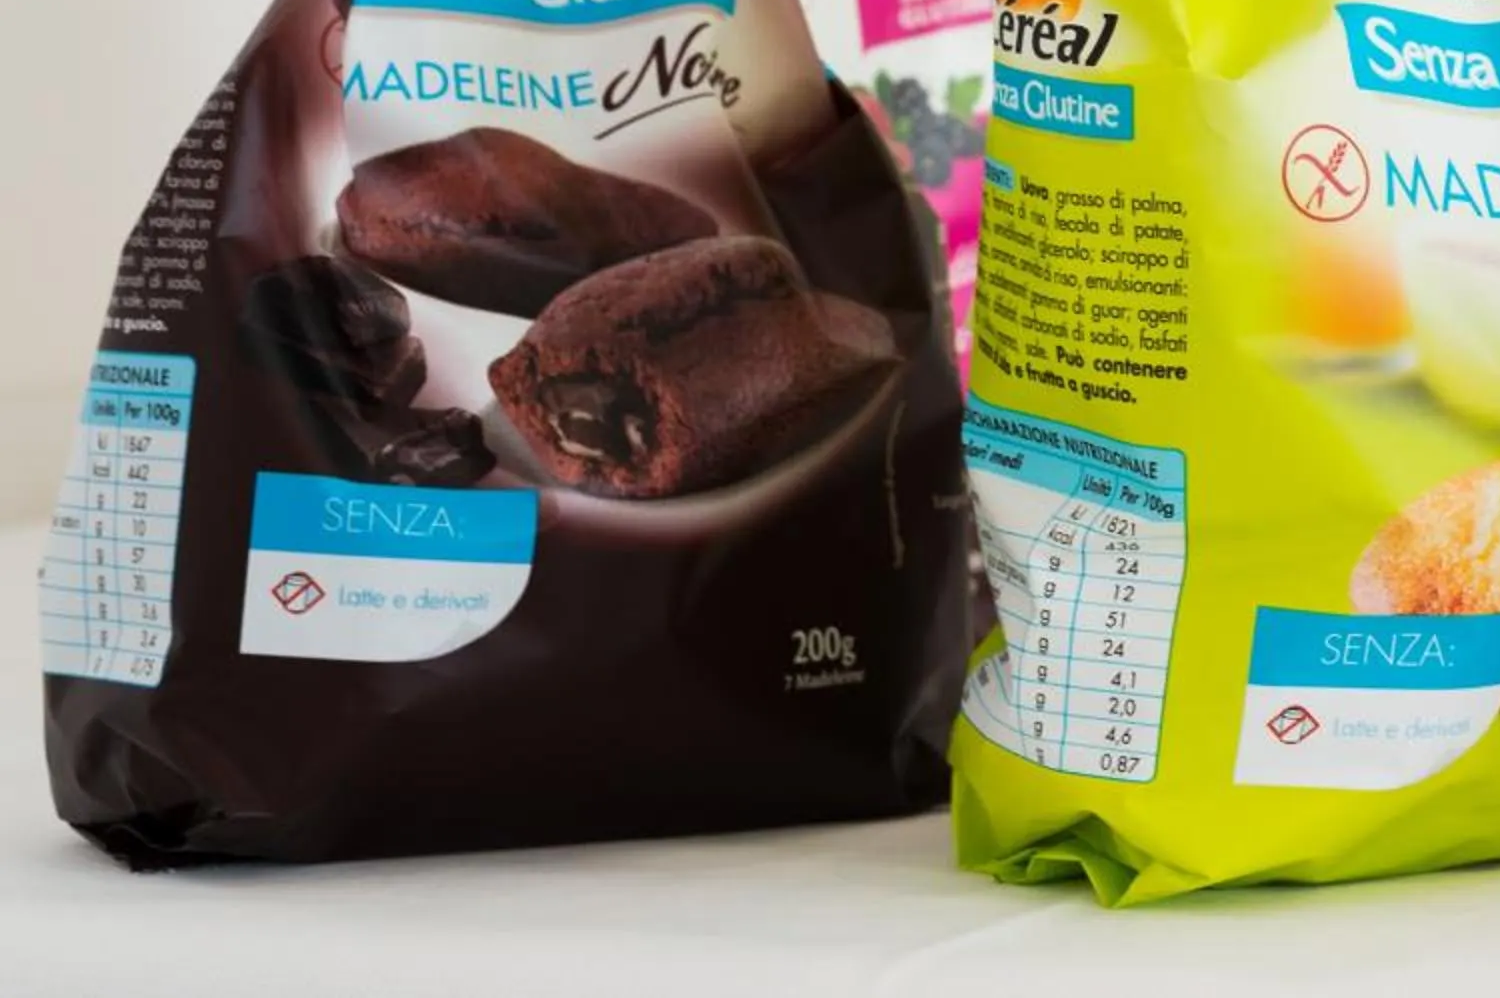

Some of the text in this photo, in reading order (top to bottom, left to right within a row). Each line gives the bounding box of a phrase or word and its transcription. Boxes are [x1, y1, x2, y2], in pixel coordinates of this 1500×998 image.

[1364, 16, 1500, 91] Senza
[602, 21, 742, 113] Noire
[1023, 80, 1120, 128] Glutine
[1056, 189, 1188, 217] grasso di palma,
[1055, 207, 1099, 235] fecola
[1110, 217, 1124, 236] di
[1134, 222, 1188, 243] patate,
[1101, 248, 1168, 271] sciroppo
[1174, 249, 1189, 269] di
[1086, 272, 1188, 298] emulsionanti:
[1138, 306, 1188, 328] agenti
[1090, 328, 1134, 351] sodio,
[1139, 328, 1188, 353] fosfati
[1056, 346, 1188, 381] Può contenere
[1026, 362, 1065, 389] frutta
[1068, 381, 1078, 393] a
[1082, 382, 1138, 405] guscio.
[1064, 435, 1158, 479] NUTRIZIONALE
[1119, 485, 1139, 504] Per
[1143, 491, 1175, 519] 100g
[1101, 514, 1137, 537] 1821
[1116, 557, 1140, 577] 24
[338, 585, 489, 614] Latte e derivati
[1113, 584, 1136, 604] 12
[1105, 611, 1128, 630] 51
[791, 626, 857, 668] 200g
[1103, 639, 1125, 658] 24
[1320, 632, 1455, 668] SENZA:
[1111, 669, 1137, 691] 4,1
[1109, 697, 1137, 719] 2,0
[1105, 726, 1132, 748] 4,6
[1332, 717, 1379, 739] Latte
[1385, 724, 1399, 739] e
[1100, 752, 1140, 775] 0,87
